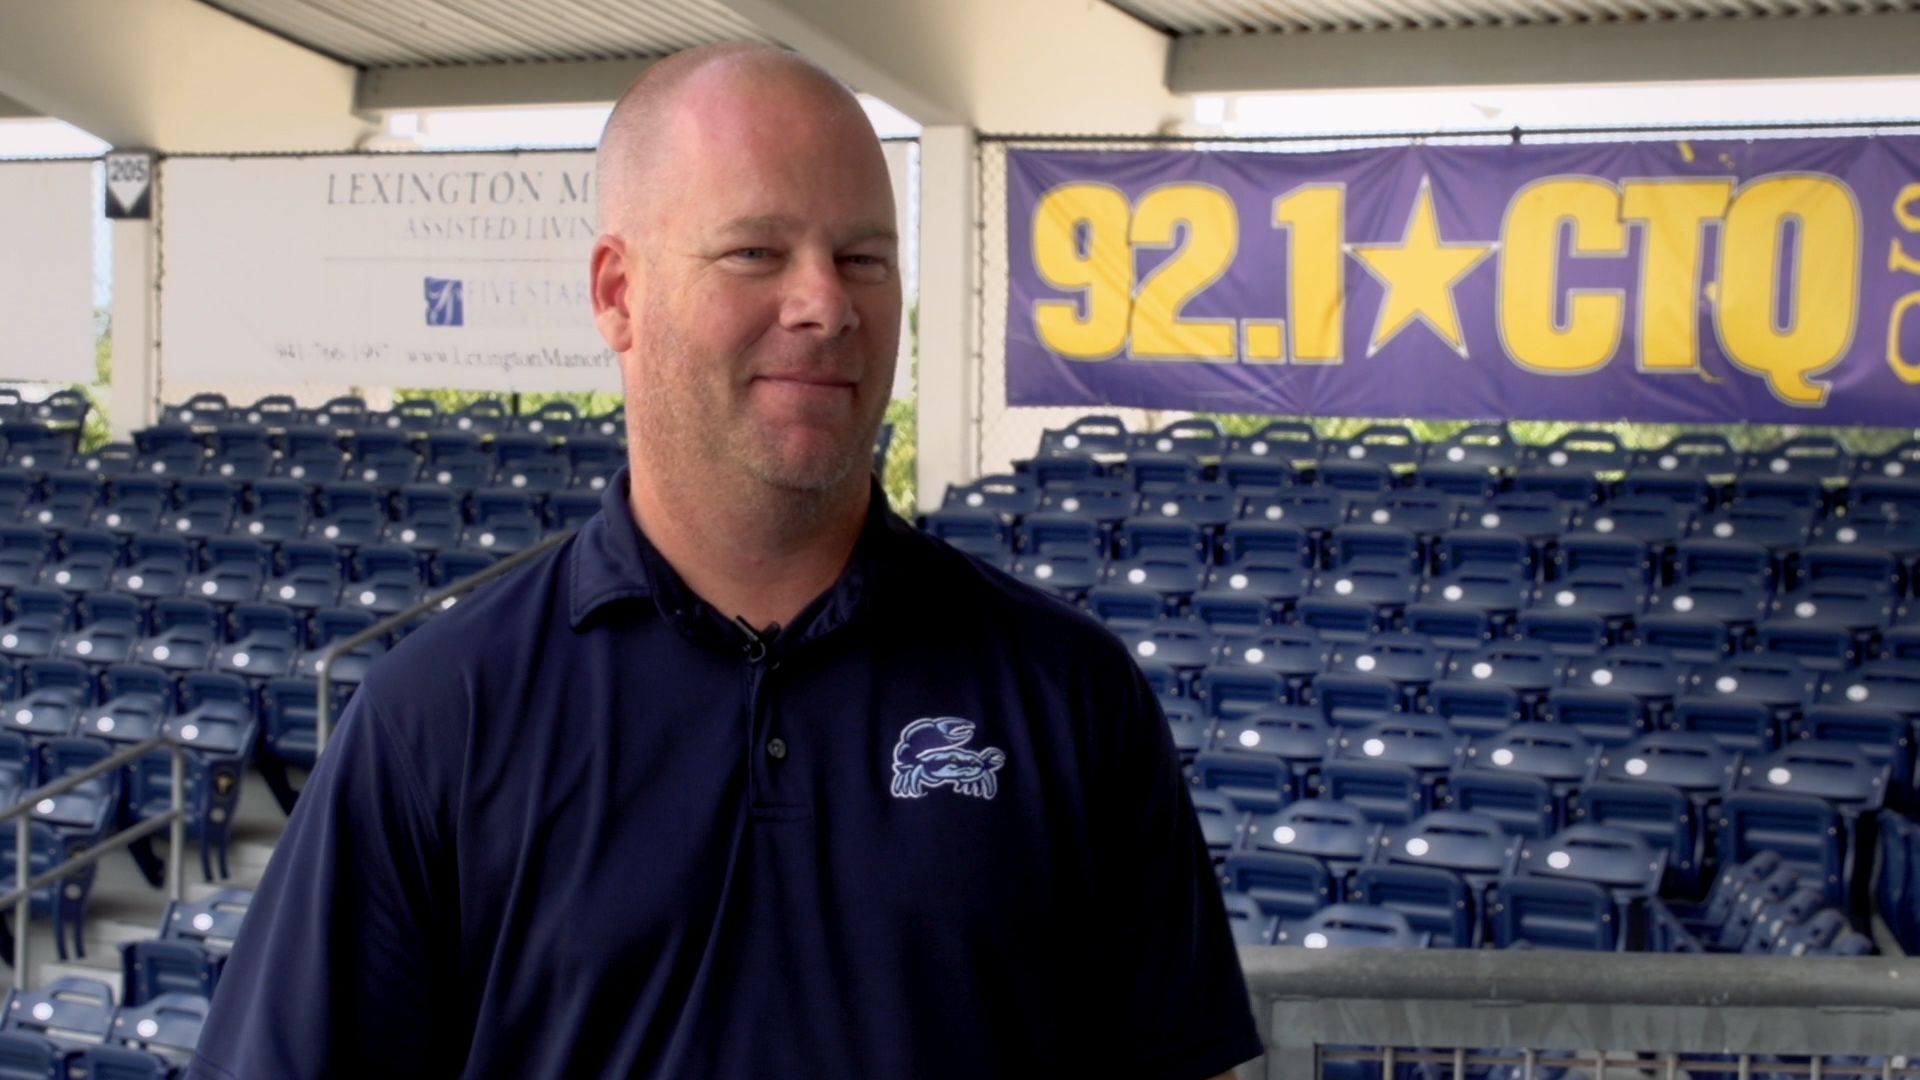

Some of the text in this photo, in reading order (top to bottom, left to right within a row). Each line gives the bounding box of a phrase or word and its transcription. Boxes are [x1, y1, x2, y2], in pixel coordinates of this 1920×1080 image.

[110, 159, 148, 182] 205
[326, 170, 544, 206] LEXINGTON
[402, 214, 518, 240] ASSISTED
[1031, 181, 1347, 365] 92.1
[1496, 170, 1863, 408] CTQ
